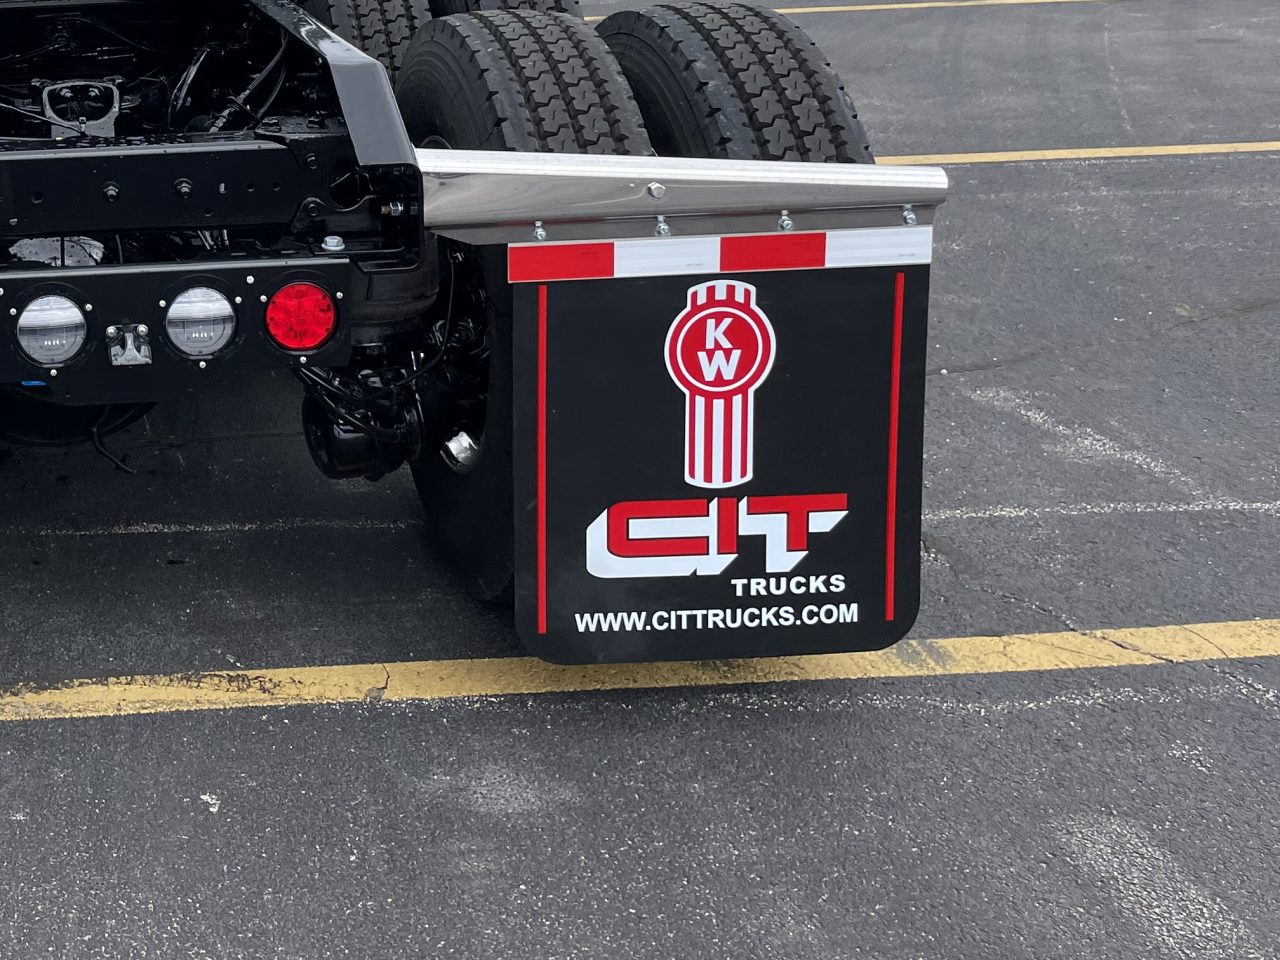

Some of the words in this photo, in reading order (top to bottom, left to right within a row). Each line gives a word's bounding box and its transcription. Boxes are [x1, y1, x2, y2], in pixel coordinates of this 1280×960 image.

[586, 493, 849, 579] CIT
[730, 574, 846, 597] TRUCKS
[574, 603, 859, 632] WWW.CITTRUCKS.COM
